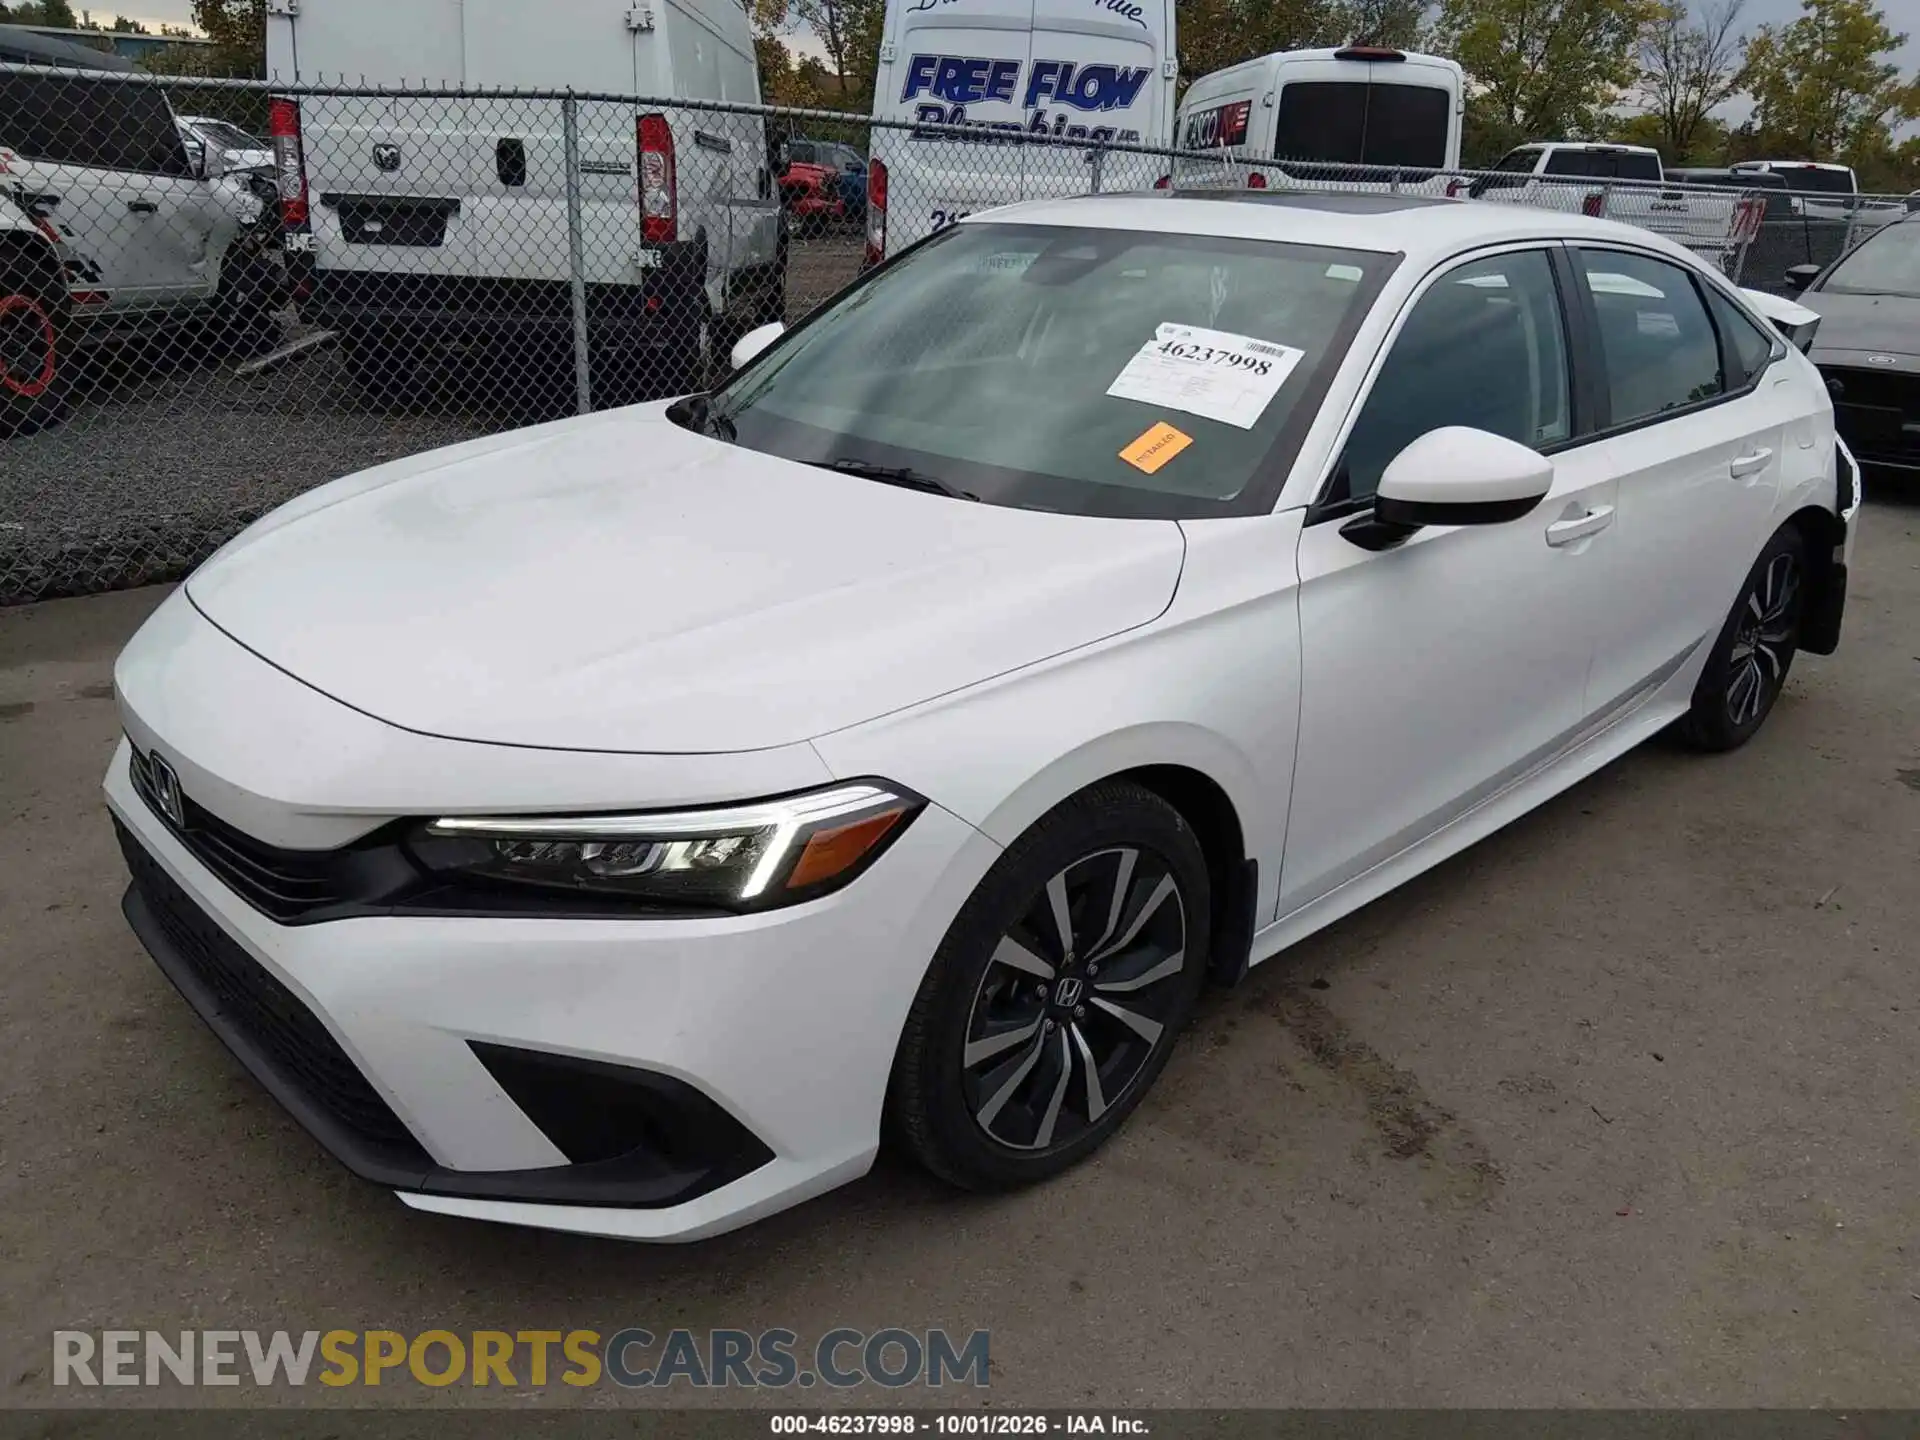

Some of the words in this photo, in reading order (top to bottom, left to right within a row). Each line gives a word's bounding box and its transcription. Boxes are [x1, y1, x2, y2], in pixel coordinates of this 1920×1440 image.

[901, 53, 1023, 105] FREE
[1022, 58, 1154, 112] FLOW
[1157, 339, 1273, 377] 46237998
